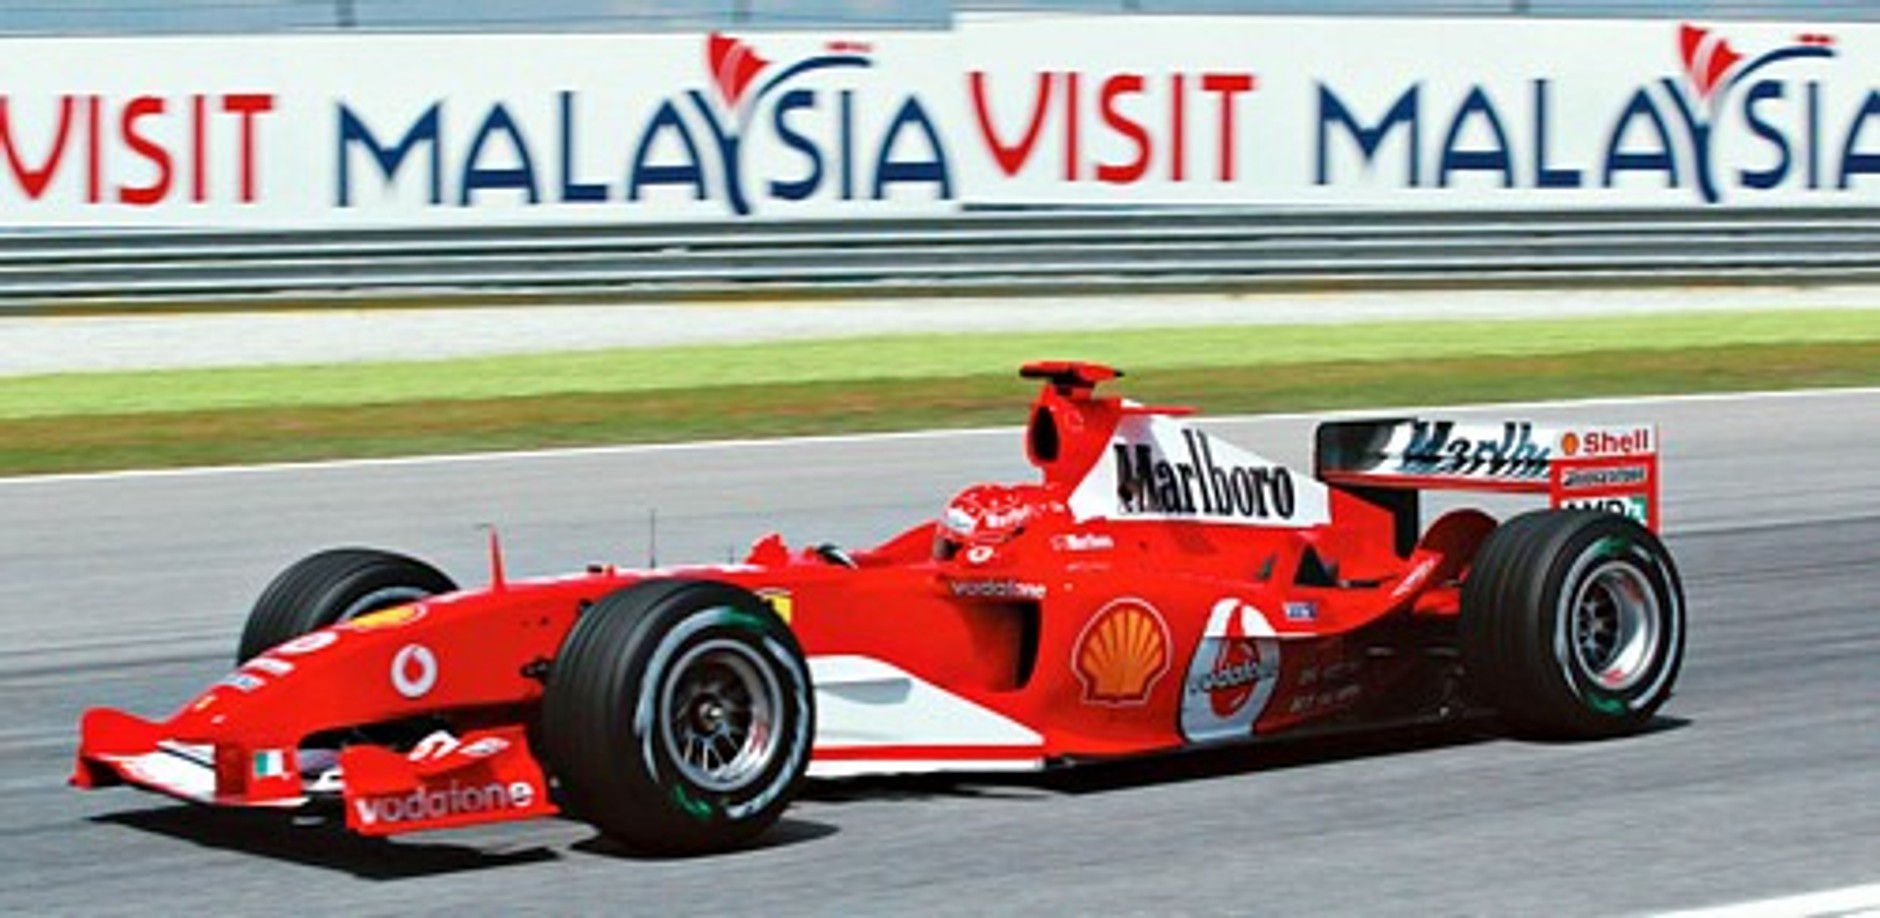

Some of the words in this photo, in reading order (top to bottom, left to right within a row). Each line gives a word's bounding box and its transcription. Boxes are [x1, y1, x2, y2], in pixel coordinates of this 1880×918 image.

[0, 93, 275, 206] VISIT
[335, 80, 954, 216] MALAYSIA
[968, 72, 1256, 184] VISIT
[1113, 428, 1295, 520] Marlboro
[1583, 428, 1648, 452] Shell
